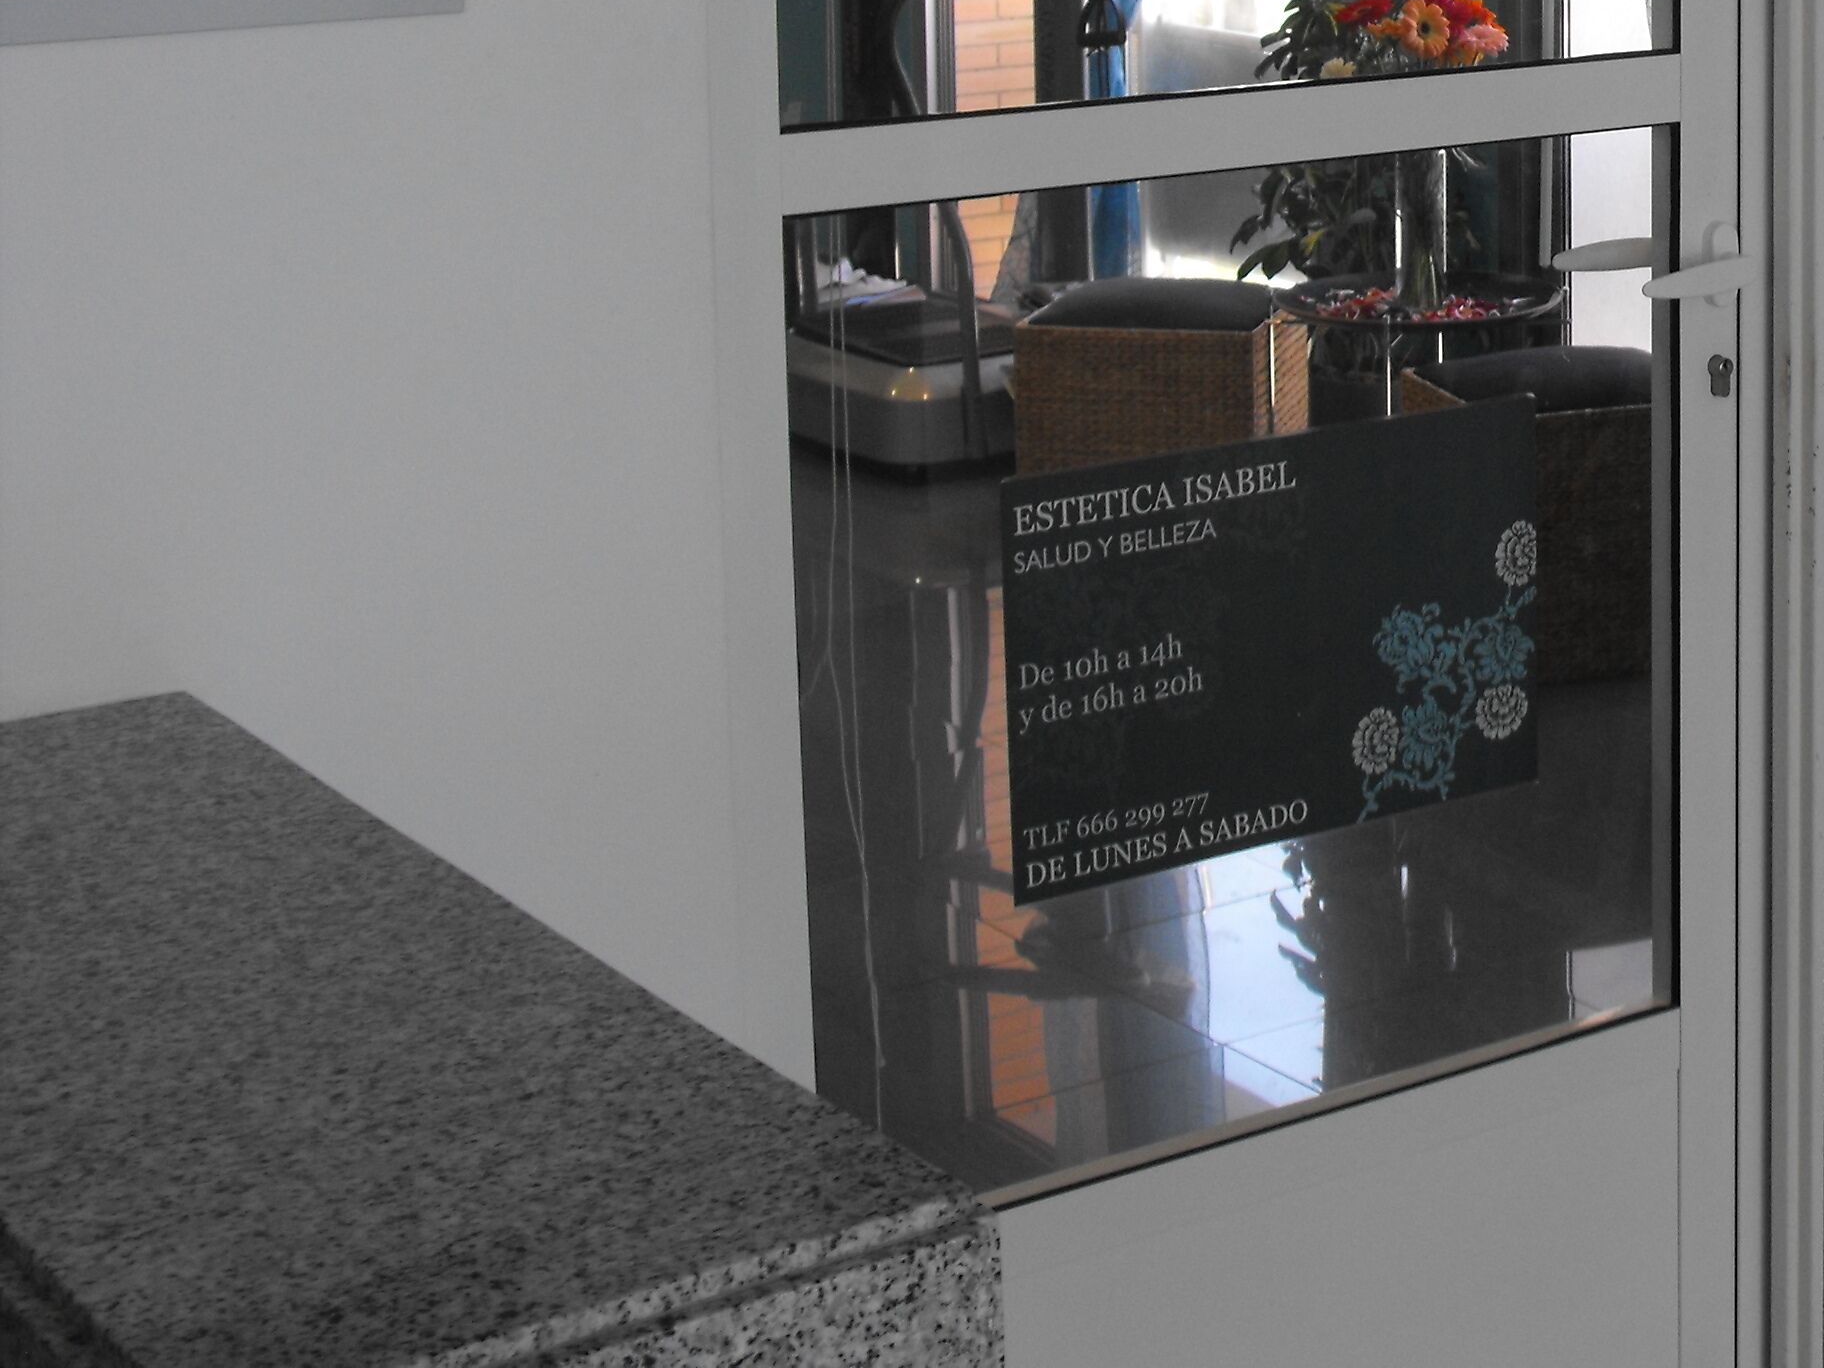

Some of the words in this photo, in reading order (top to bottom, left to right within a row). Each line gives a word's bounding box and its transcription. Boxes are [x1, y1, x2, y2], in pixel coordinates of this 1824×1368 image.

[1014, 481, 1175, 536] ESTETICA
[1182, 461, 1297, 507] ISABEL
[1014, 541, 1092, 575] SALUD
[1098, 536, 1113, 558] Y
[1120, 519, 1217, 555] BELLEZA
[1019, 663, 1054, 690] De
[1062, 648, 1109, 680] 10h
[1117, 652, 1131, 670] a
[1138, 633, 1183, 668] 14h
[1020, 706, 1034, 733] y
[1041, 693, 1073, 724] de
[1080, 680, 1122, 716] 16h
[1133, 686, 1147, 704] a
[1155, 669, 1203, 699] 20h
[1024, 821, 1069, 851] TLF
[1077, 807, 1117, 838] 666
[1125, 802, 1165, 830] 299
[1173, 792, 1209, 820] 277
[1026, 858, 1066, 889] DE
[1074, 831, 1167, 874] LUNES
[1173, 827, 1194, 851] A
[1200, 799, 1308, 846] SABADO
